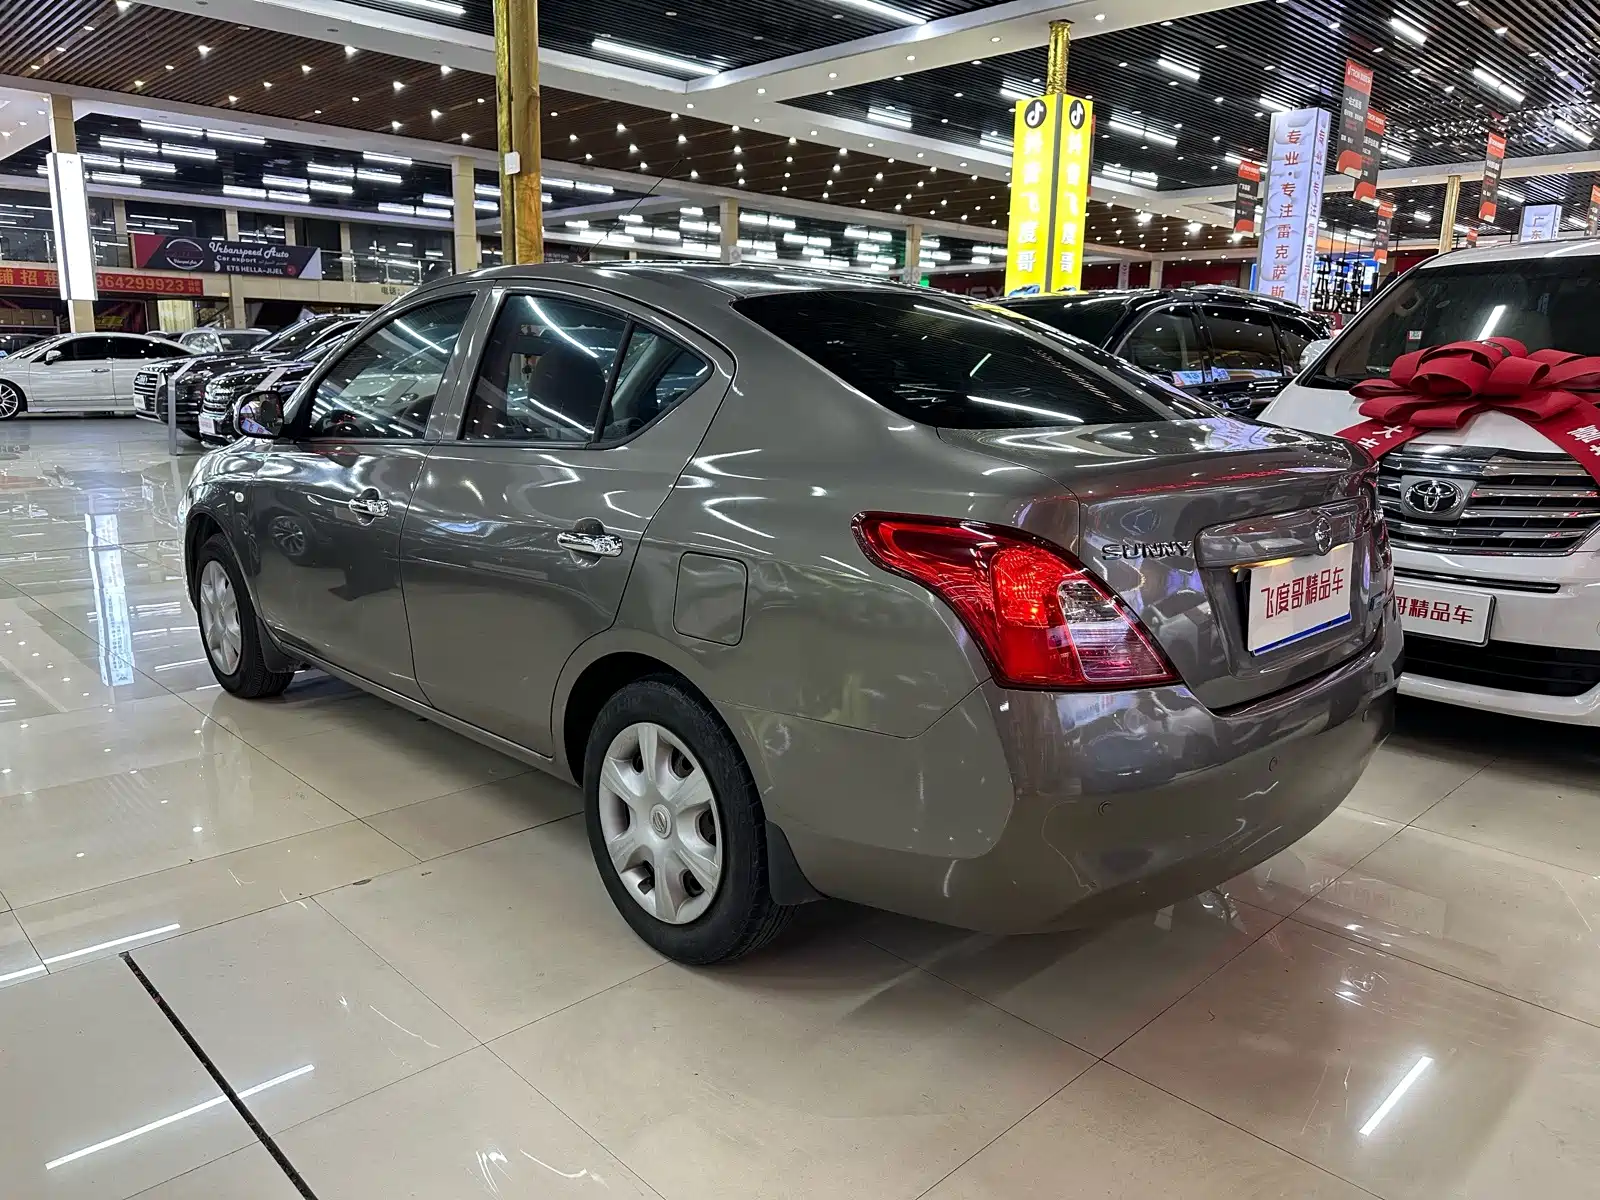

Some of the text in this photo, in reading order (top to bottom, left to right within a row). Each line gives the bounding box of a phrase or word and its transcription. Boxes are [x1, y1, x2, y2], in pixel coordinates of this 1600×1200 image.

[209, 241, 289, 259] Urbanspeed Auto
[216, 254, 230, 262] Car
[1101, 540, 1192, 561] SUNNY
[1260, 566, 1344, 619] 飞度哥精品车
